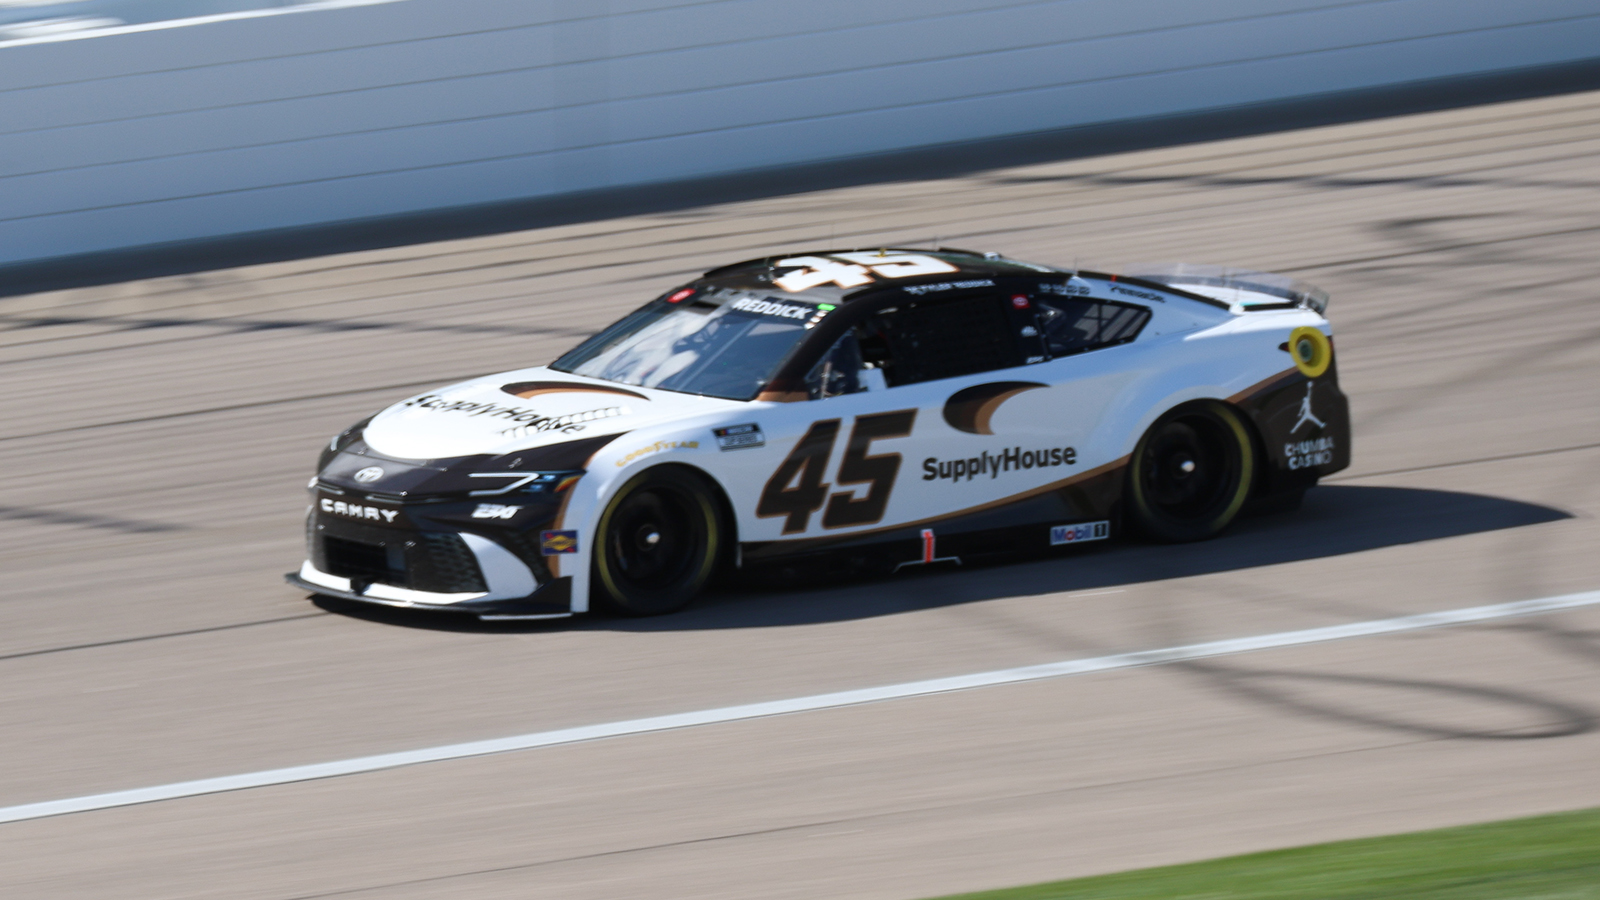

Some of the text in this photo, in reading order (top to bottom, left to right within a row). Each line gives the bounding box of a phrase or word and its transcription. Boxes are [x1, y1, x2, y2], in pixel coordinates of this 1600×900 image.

[773, 252, 962, 293] 45
[731, 297, 814, 320] REDDICK
[1284, 436, 1335, 458] CHUMBA
[757, 407, 920, 537] 45
[922, 446, 1078, 484] SupplyHouse
[1288, 451, 1333, 471] CASINO
[320, 498, 400, 523] CAMRY
[1053, 525, 1092, 542] Mobil
